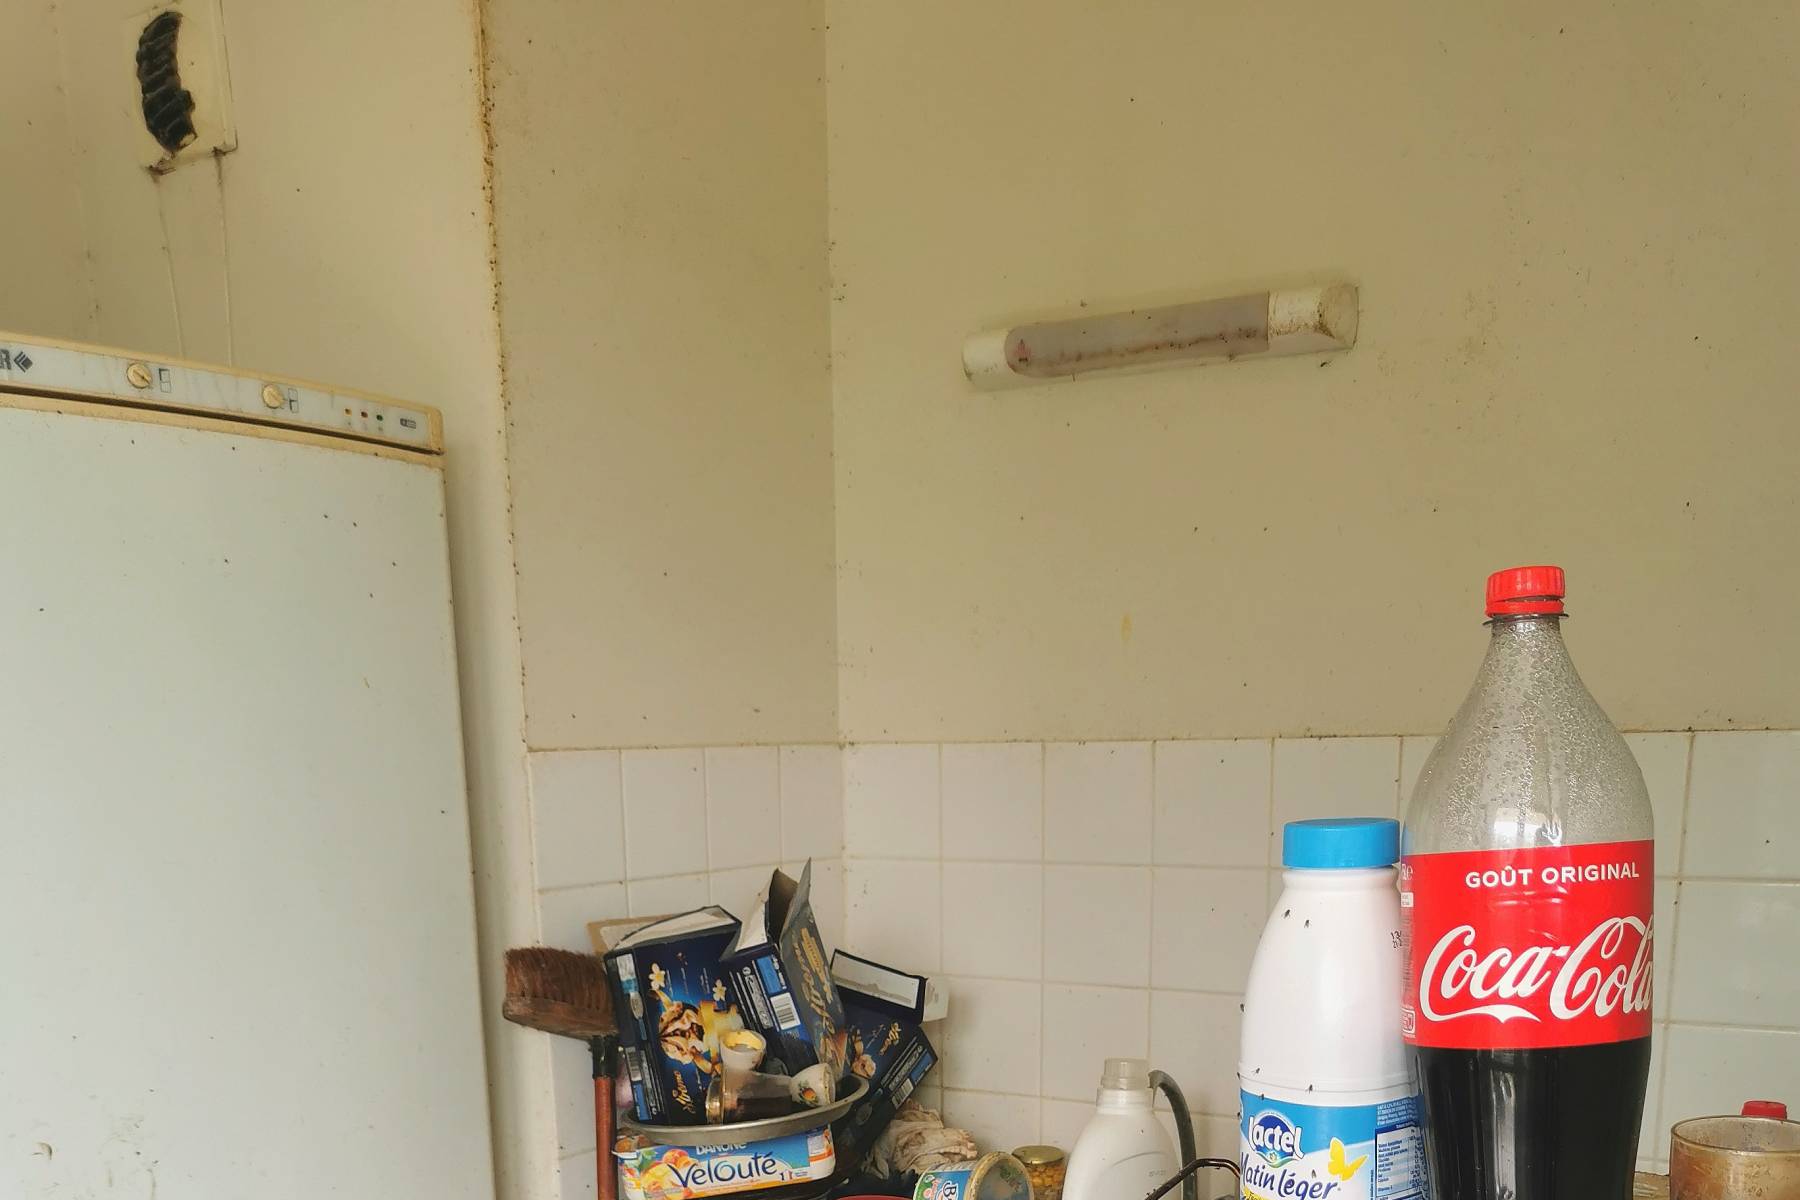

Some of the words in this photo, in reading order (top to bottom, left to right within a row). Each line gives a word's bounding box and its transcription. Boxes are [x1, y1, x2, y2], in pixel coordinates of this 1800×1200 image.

[1465, 865, 1533, 888] GOÛT
[1541, 862, 1639, 886] ORIGINAL
[1420, 915, 1653, 1023] Coca-Cola
[669, 1151, 777, 1188] Velouté
